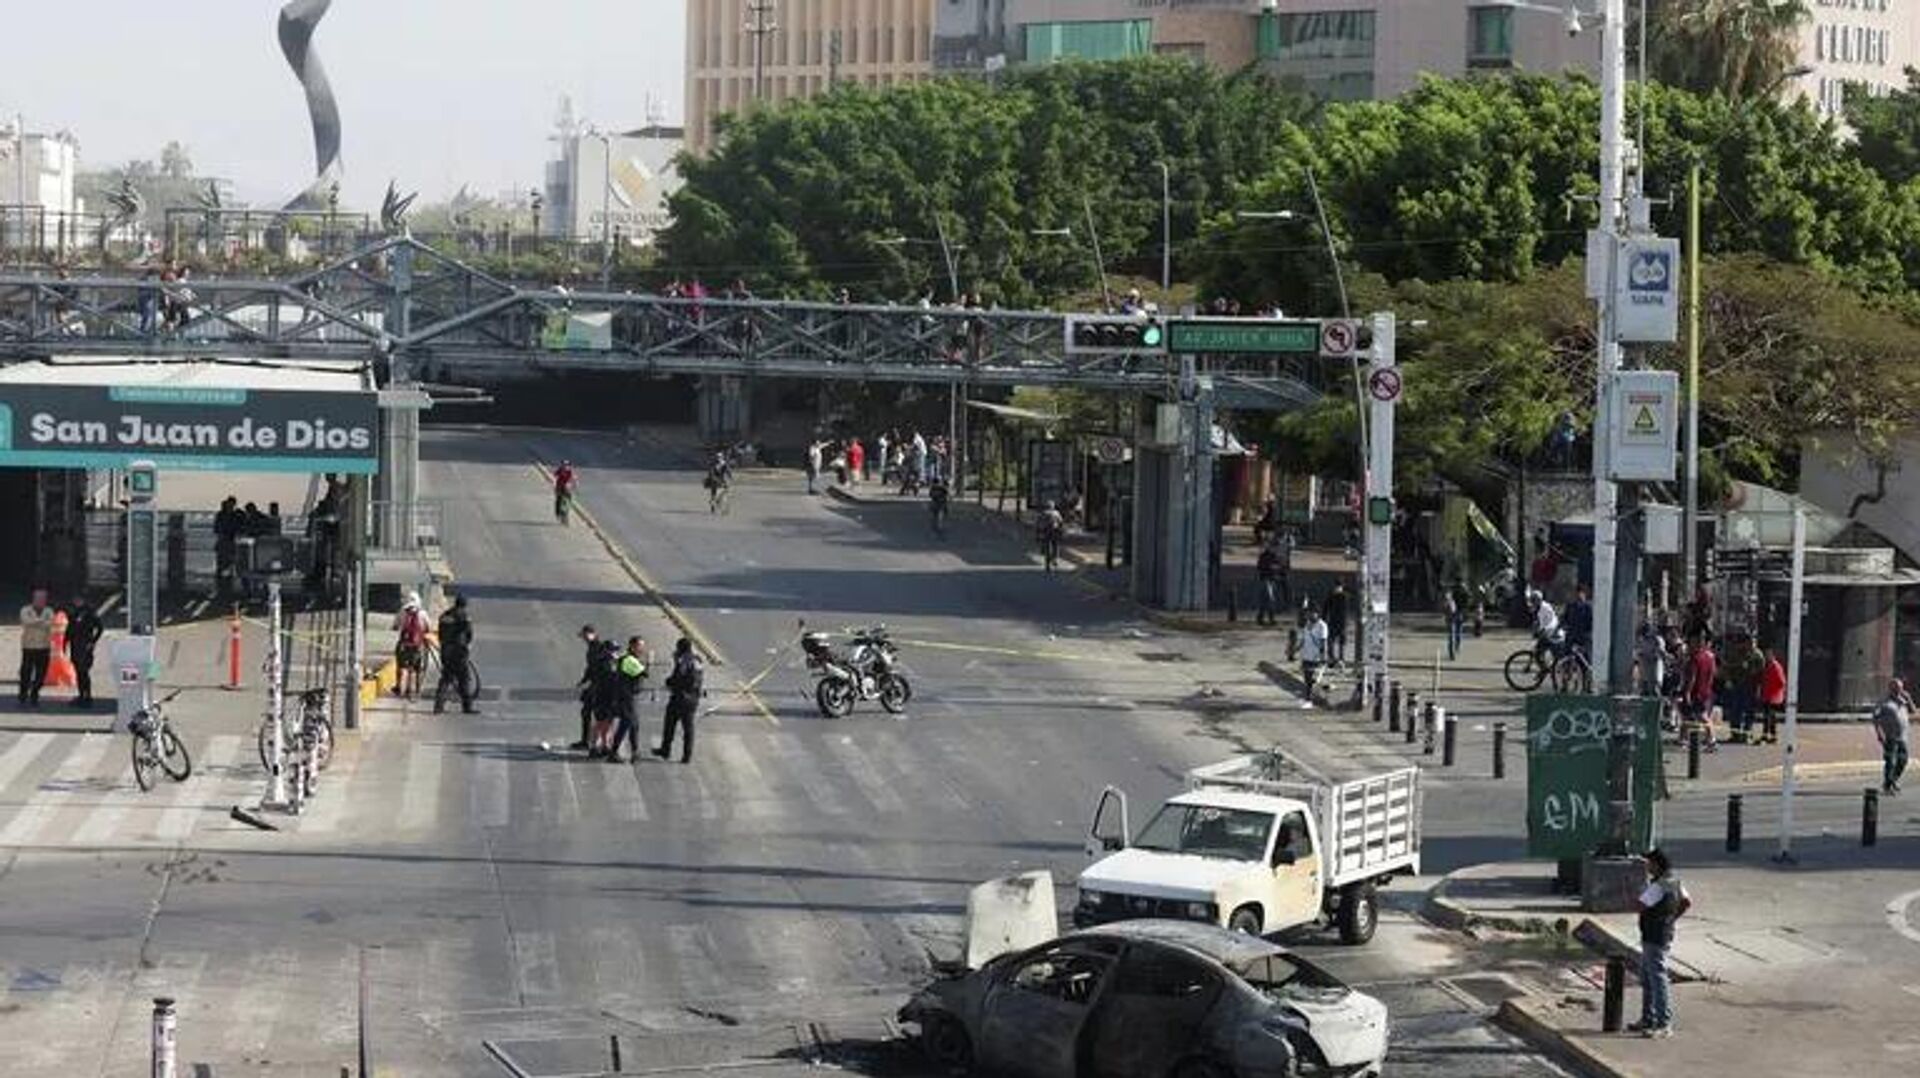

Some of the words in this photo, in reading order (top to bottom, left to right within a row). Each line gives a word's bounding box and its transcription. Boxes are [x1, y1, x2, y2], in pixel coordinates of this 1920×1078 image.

[31, 412, 109, 443] San
[117, 415, 219, 447] Juan
[228, 417, 277, 448] de
[286, 417, 370, 449] Dios
